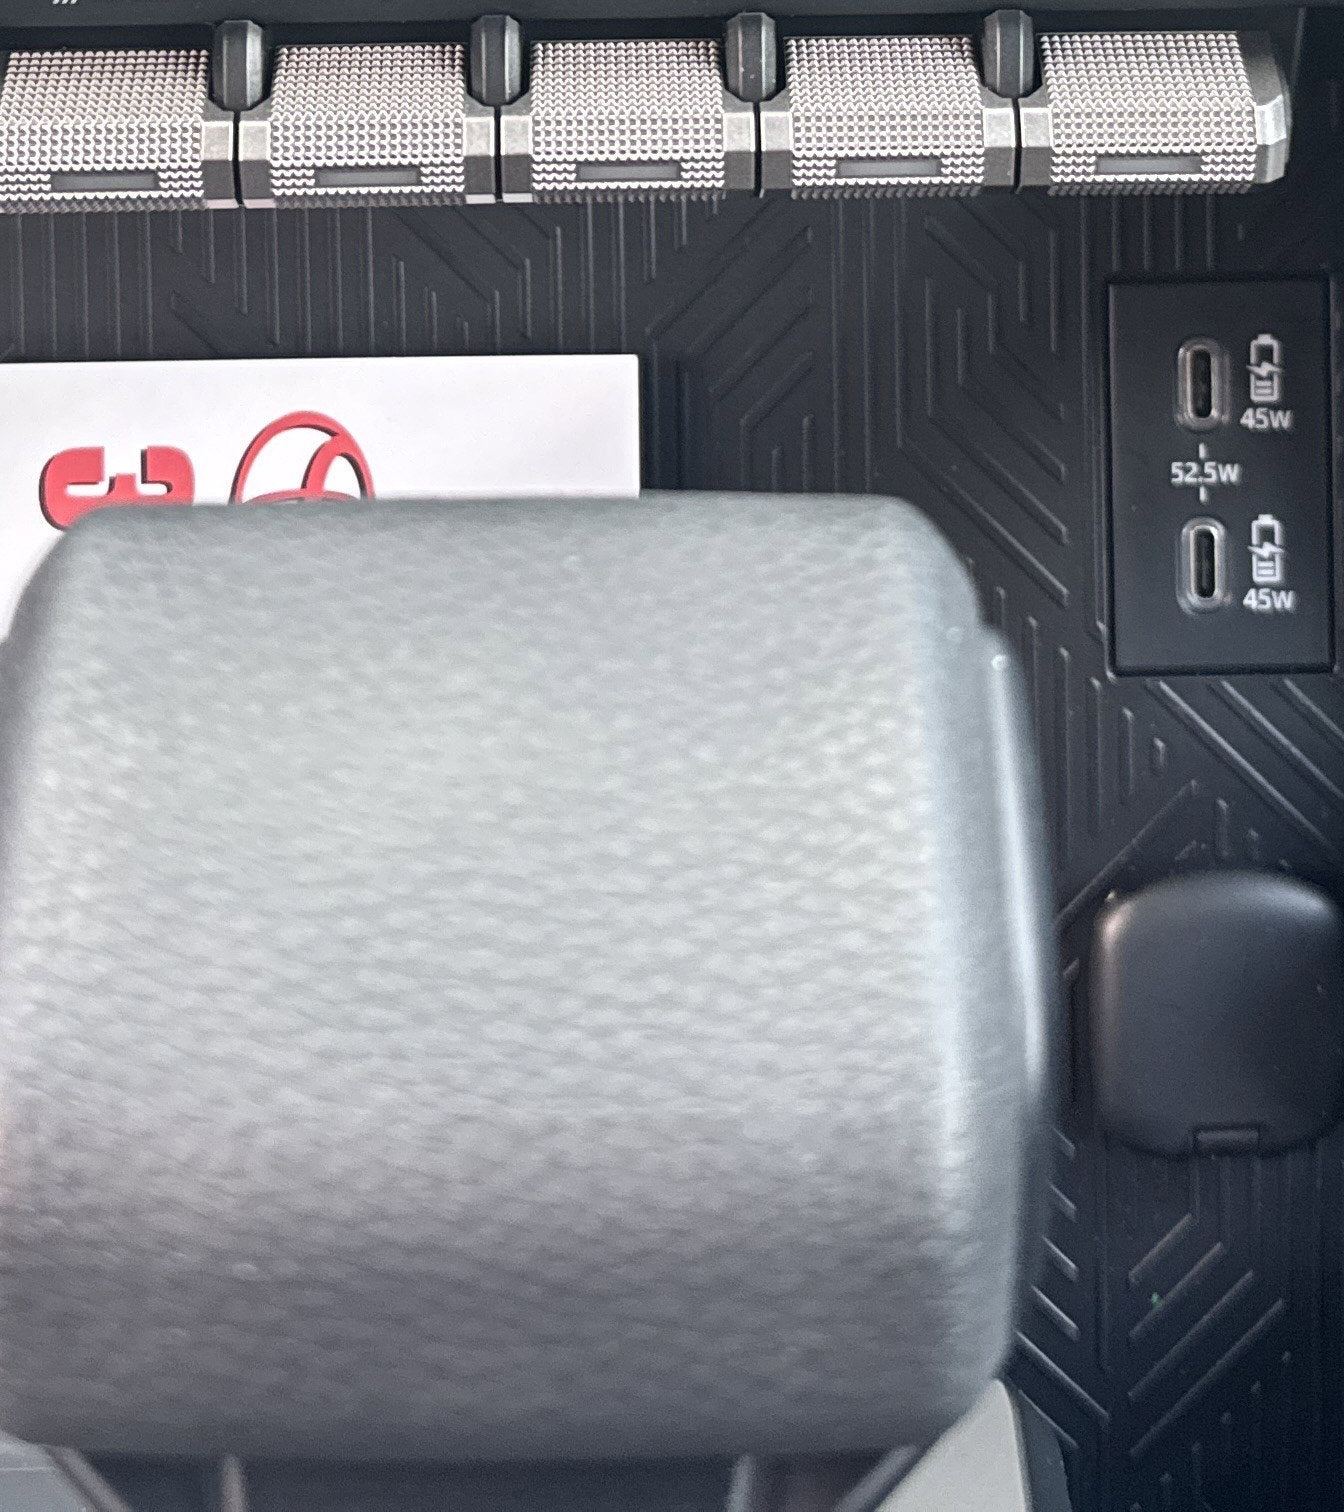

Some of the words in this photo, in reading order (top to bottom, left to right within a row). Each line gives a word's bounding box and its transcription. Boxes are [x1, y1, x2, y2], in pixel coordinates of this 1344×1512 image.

[1240, 408, 1292, 430] 45W
[1171, 461, 1240, 484] 52.5W
[1242, 588, 1294, 611] 45W
